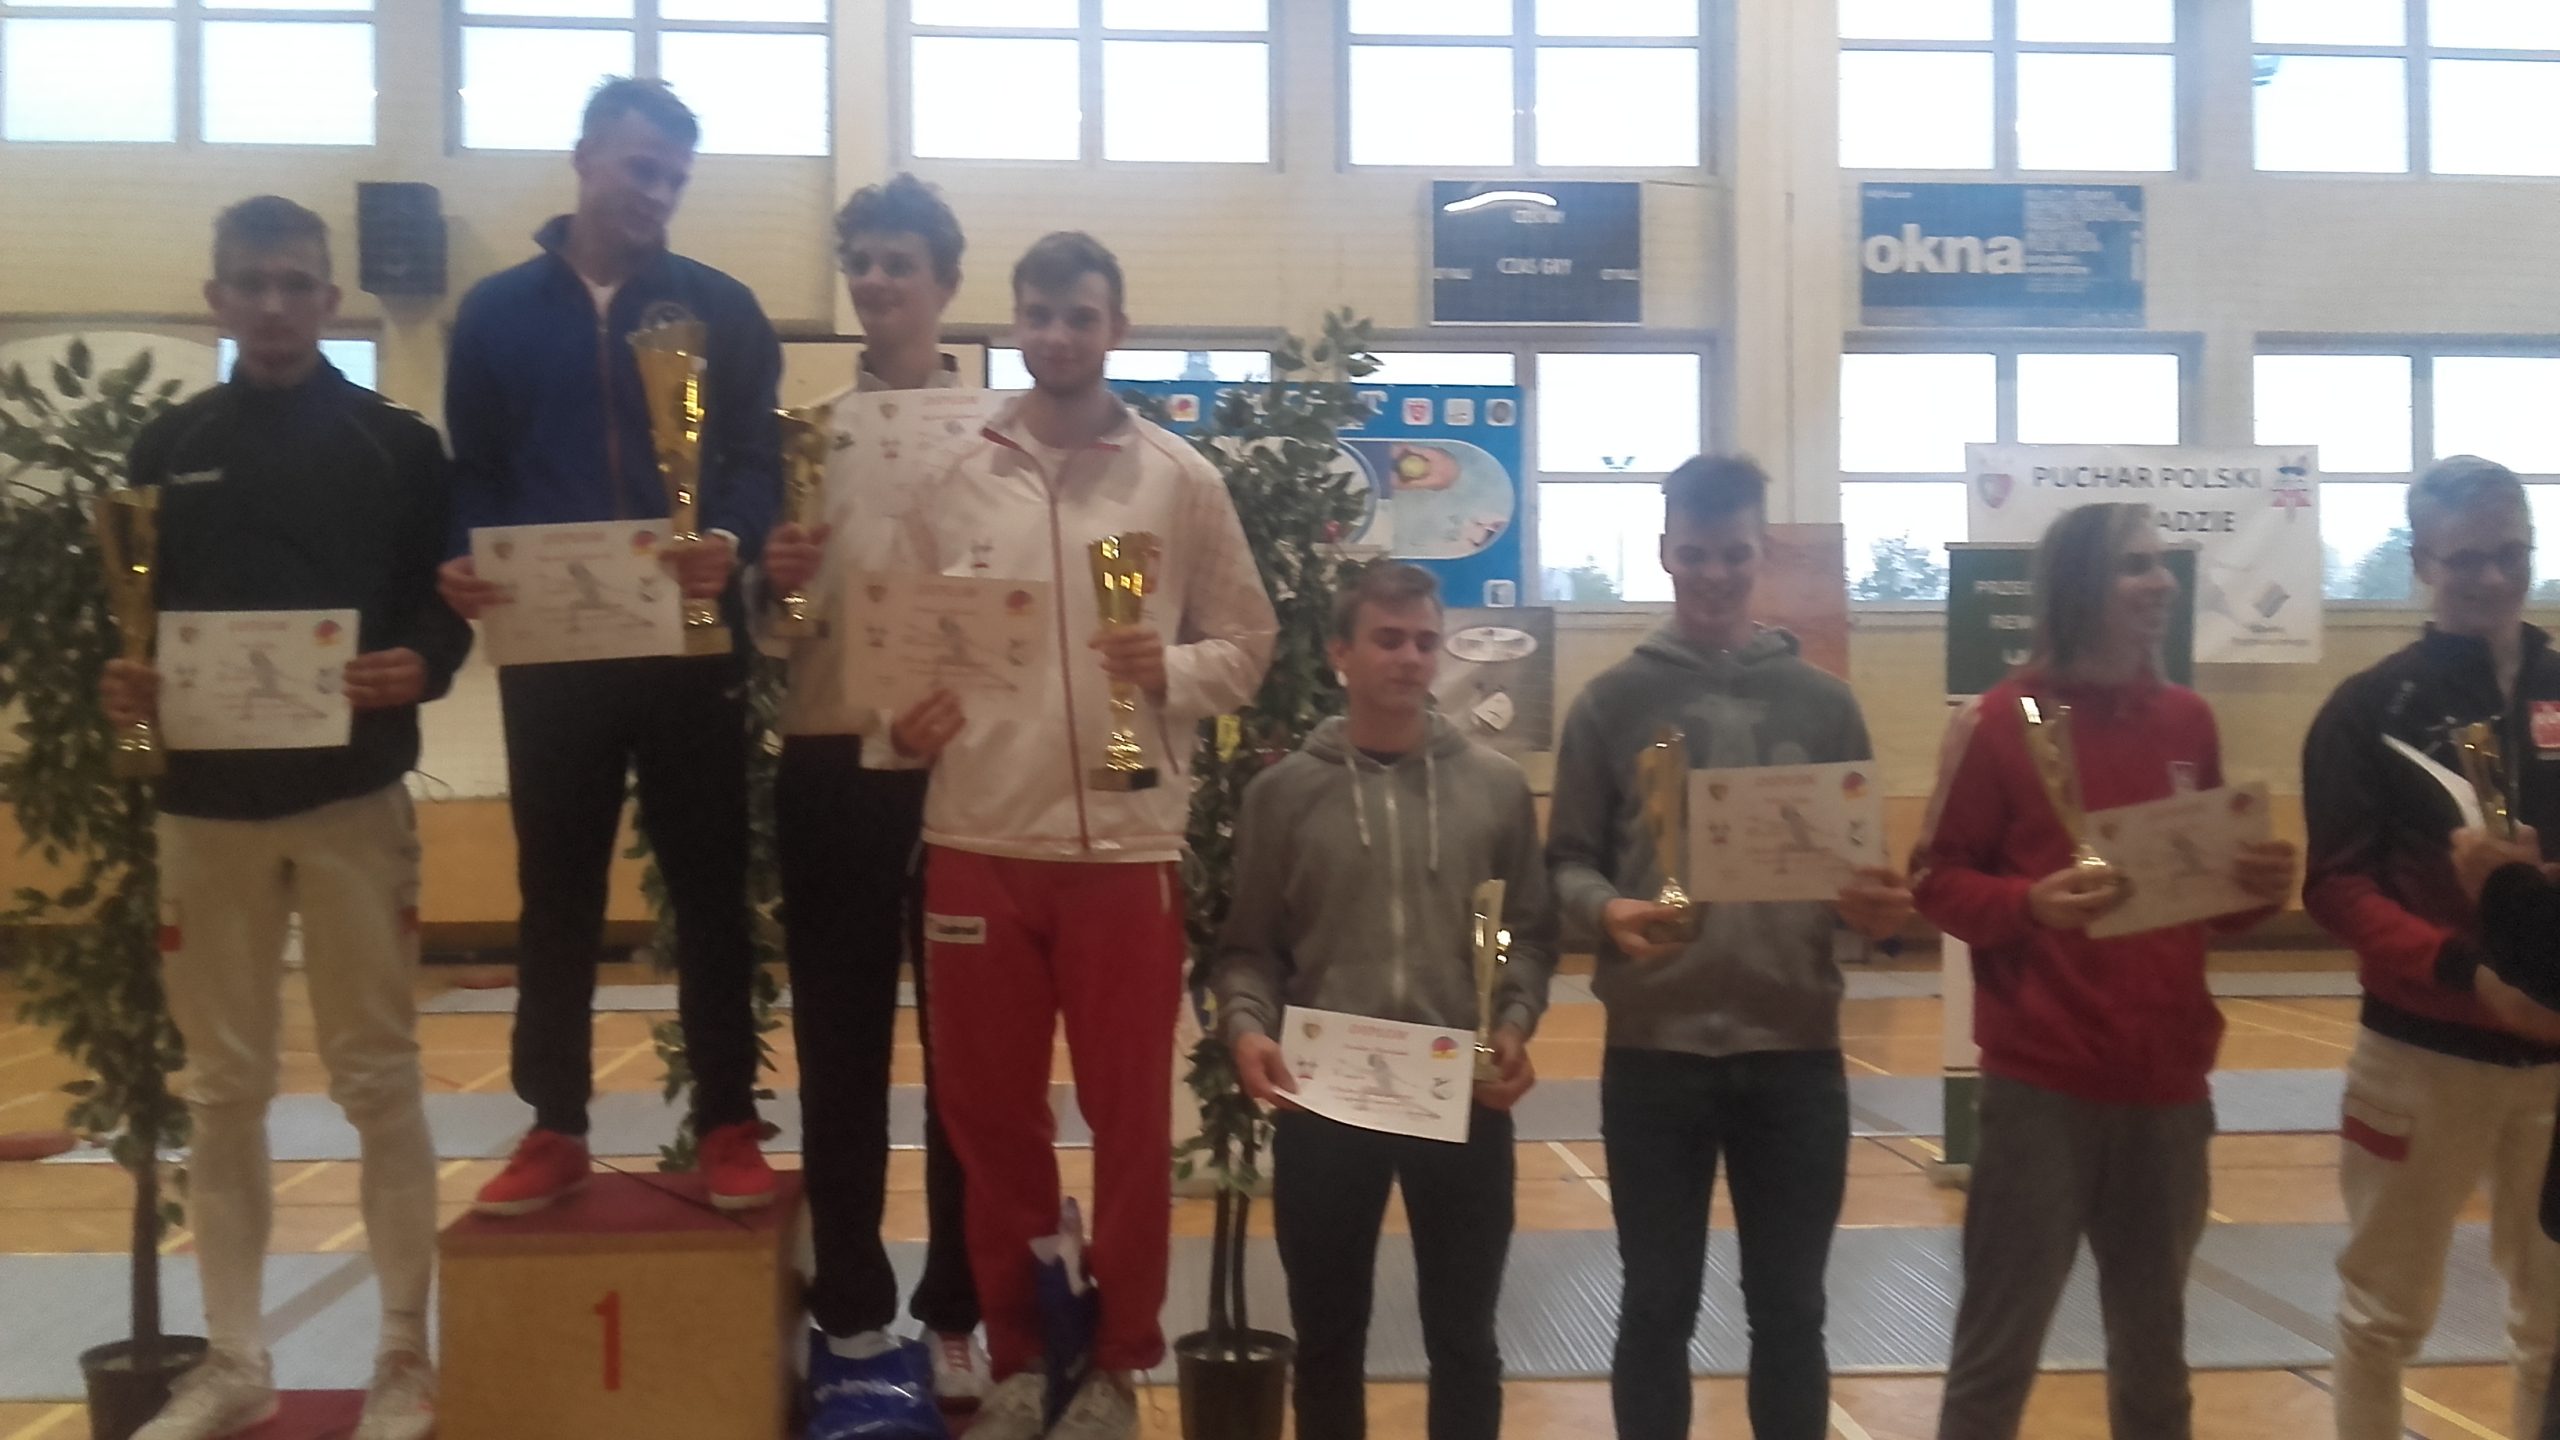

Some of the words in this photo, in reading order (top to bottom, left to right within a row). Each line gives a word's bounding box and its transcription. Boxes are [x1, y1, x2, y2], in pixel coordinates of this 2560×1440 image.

[1863, 222, 2025, 274] okna
[2032, 466, 2155, 488] PUCHAR
[2158, 466, 2261, 489] POLSKI
[2156, 510, 2236, 532] ADZIE
[594, 1289, 621, 1391] 1
